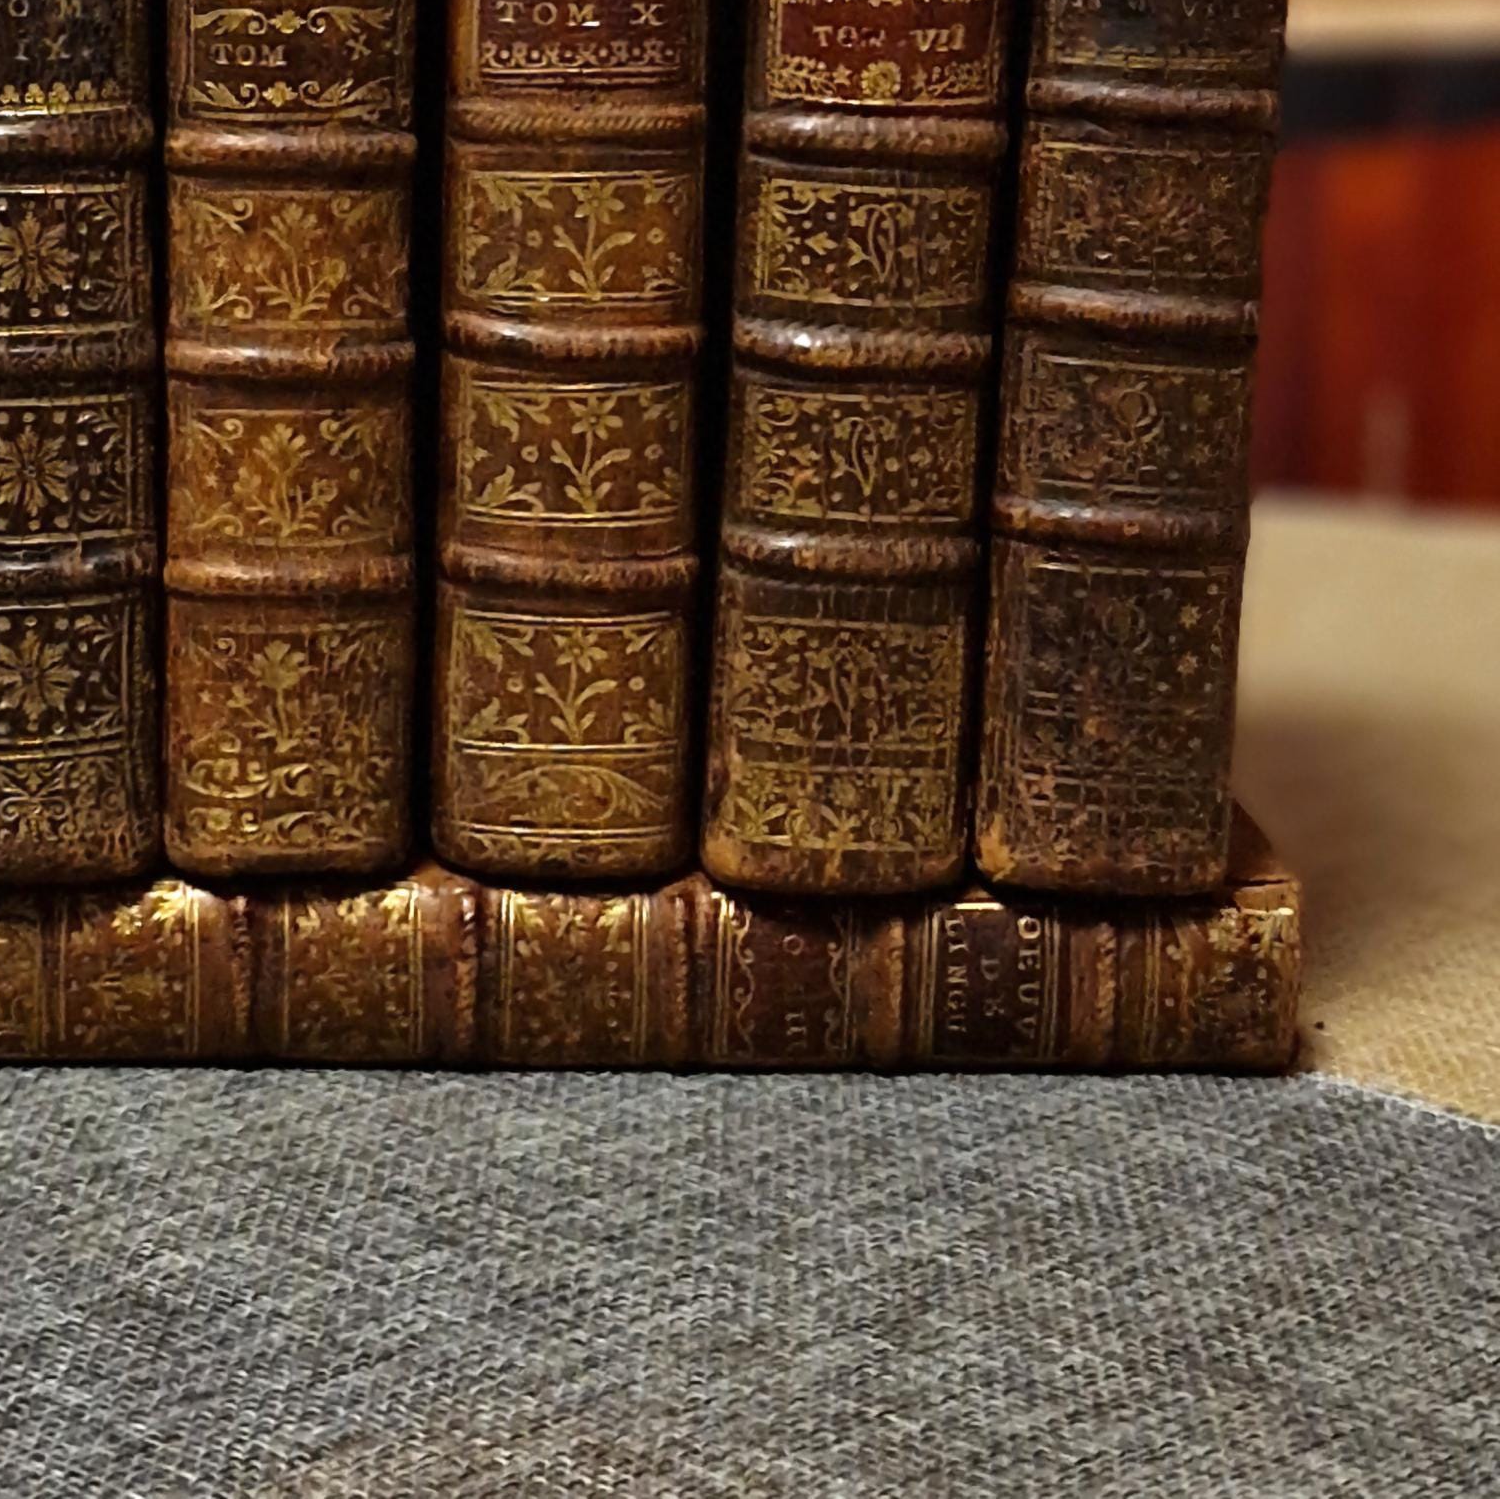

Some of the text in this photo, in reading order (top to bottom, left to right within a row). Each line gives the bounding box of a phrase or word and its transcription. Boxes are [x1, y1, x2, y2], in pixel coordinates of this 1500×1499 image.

[496, 2, 667, 28] TOM X
[210, 32, 372, 67] TOM X
